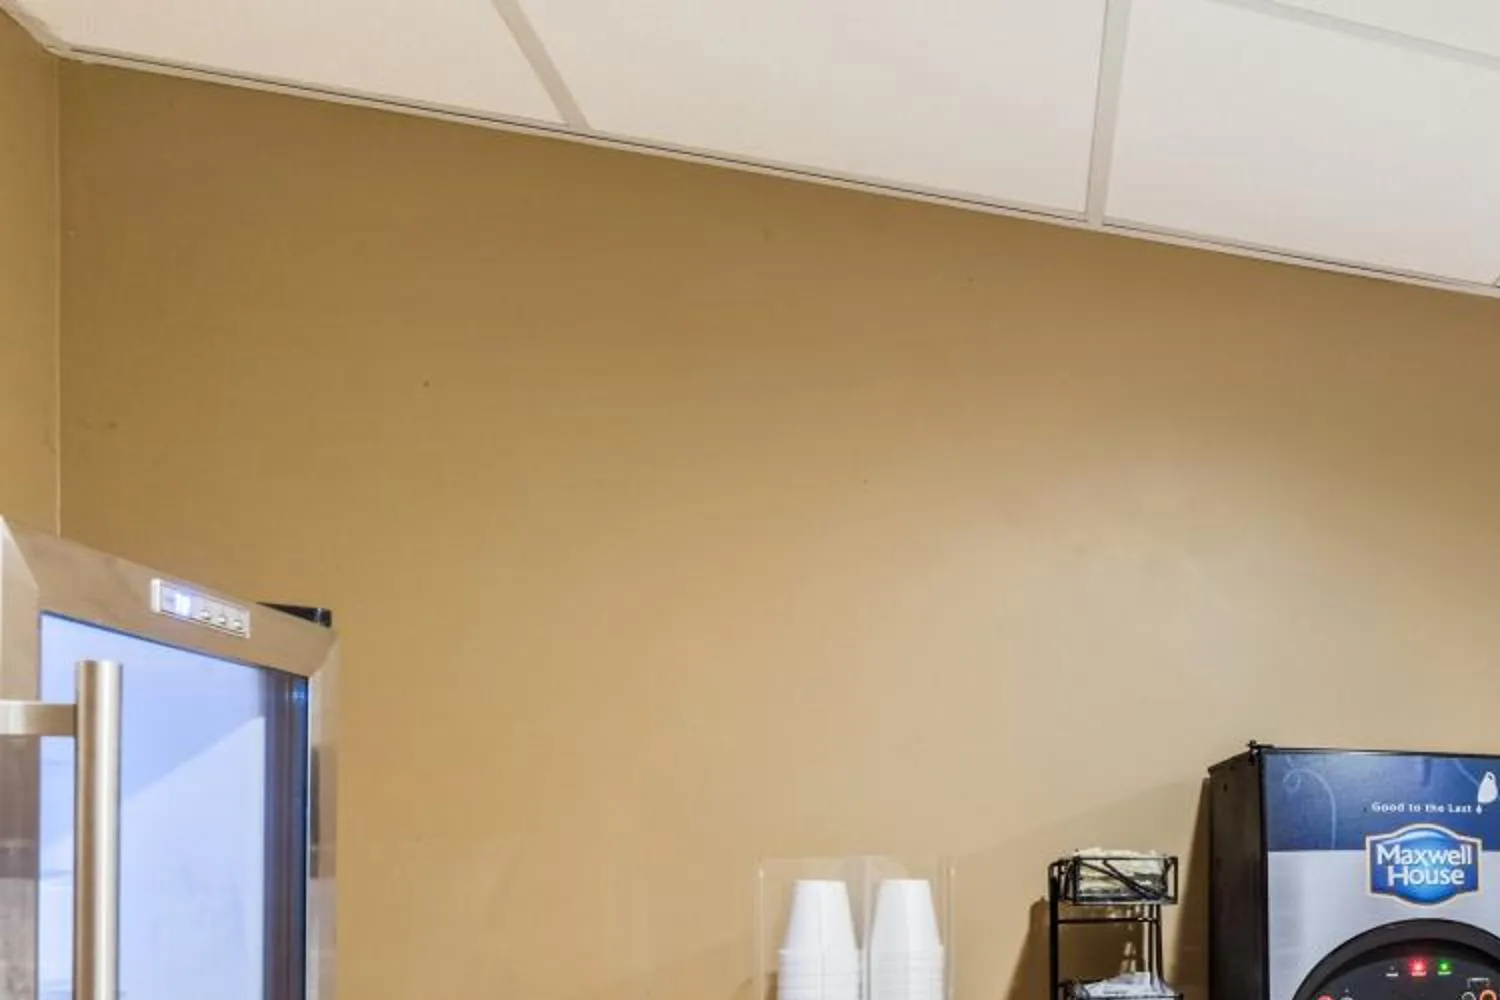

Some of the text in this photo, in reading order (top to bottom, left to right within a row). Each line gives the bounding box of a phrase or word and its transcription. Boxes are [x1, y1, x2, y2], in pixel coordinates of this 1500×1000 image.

[1371, 801, 1472, 813] Good to the Last
[1376, 843, 1473, 865] Maxwell
[1387, 865, 1465, 886] House
